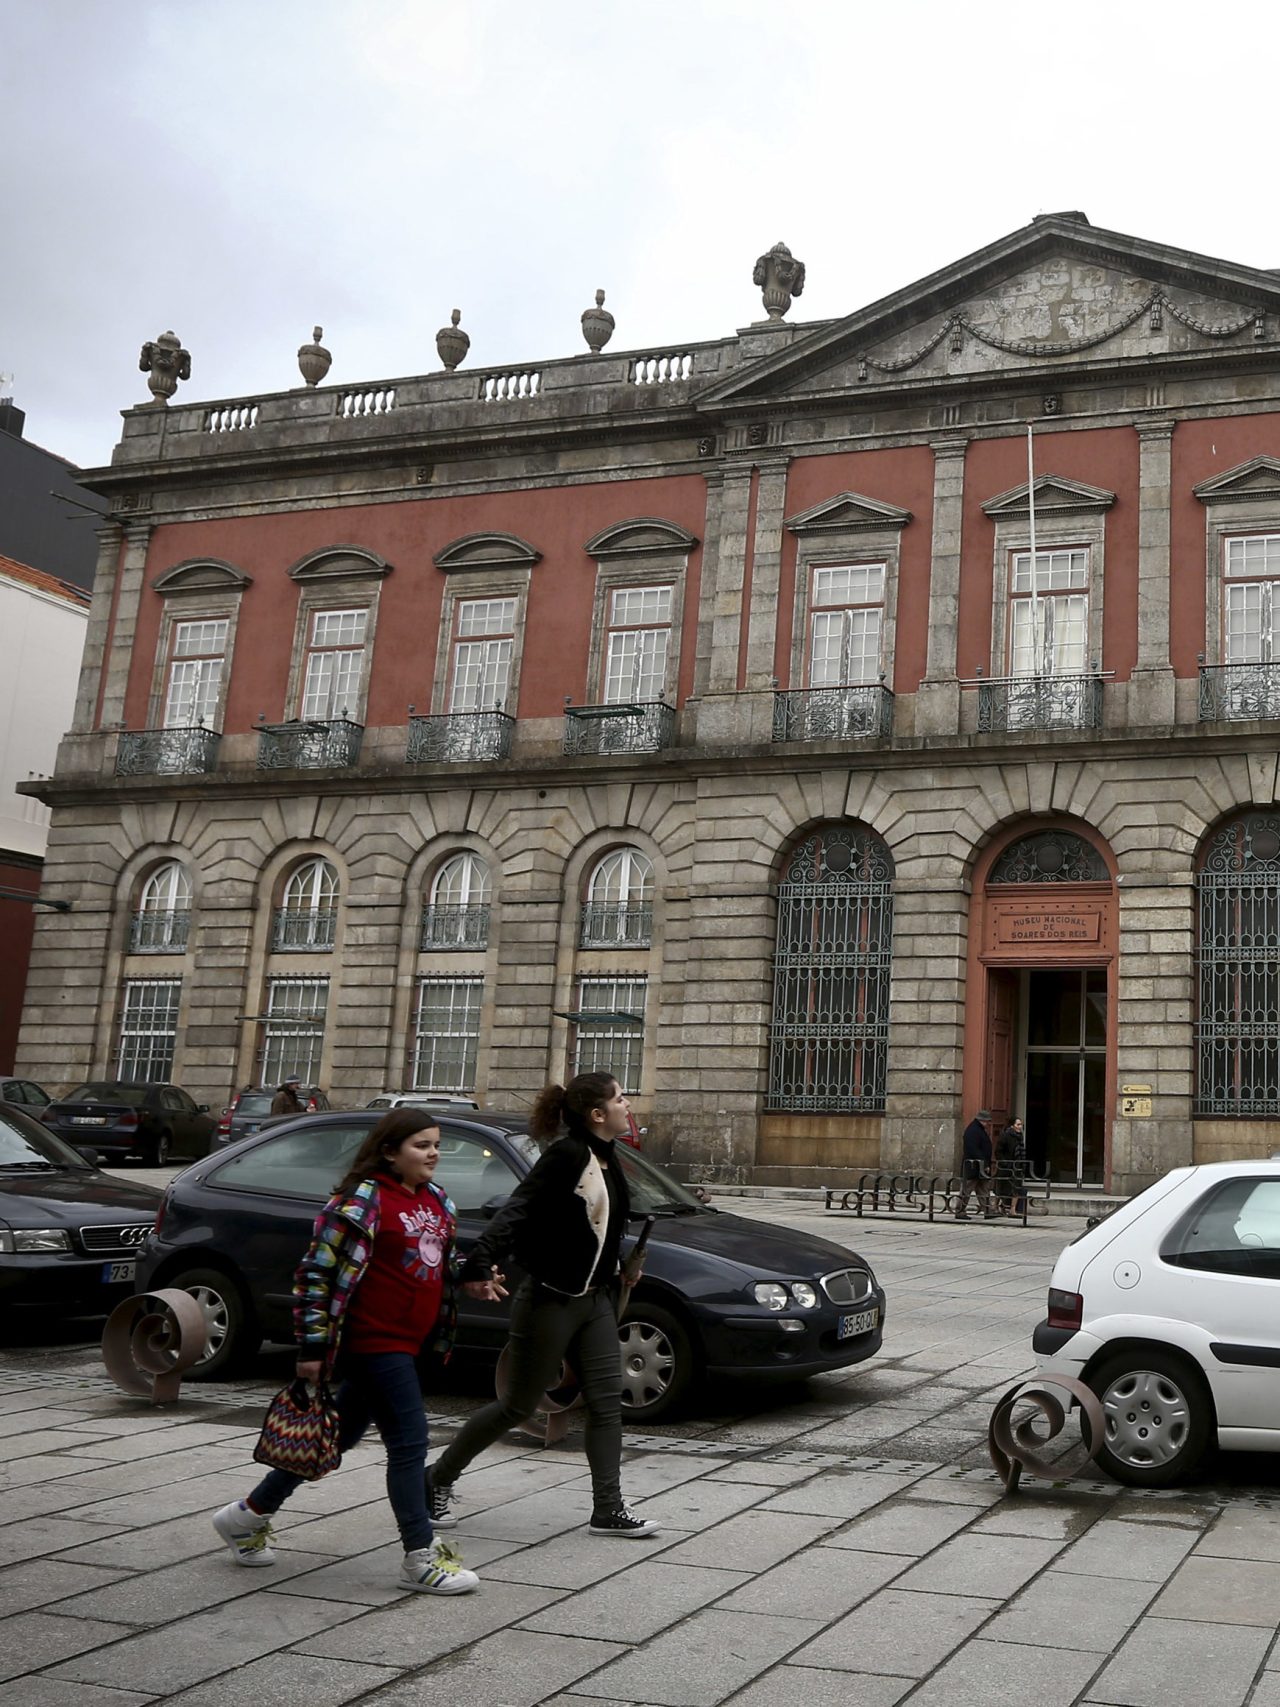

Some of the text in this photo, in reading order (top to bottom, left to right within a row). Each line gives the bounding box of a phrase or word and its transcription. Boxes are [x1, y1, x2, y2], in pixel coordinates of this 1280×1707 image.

[1013, 916, 1087, 927] MUSEU NACIONAL
[1011, 930, 1088, 939] SOARES DOS REIS
